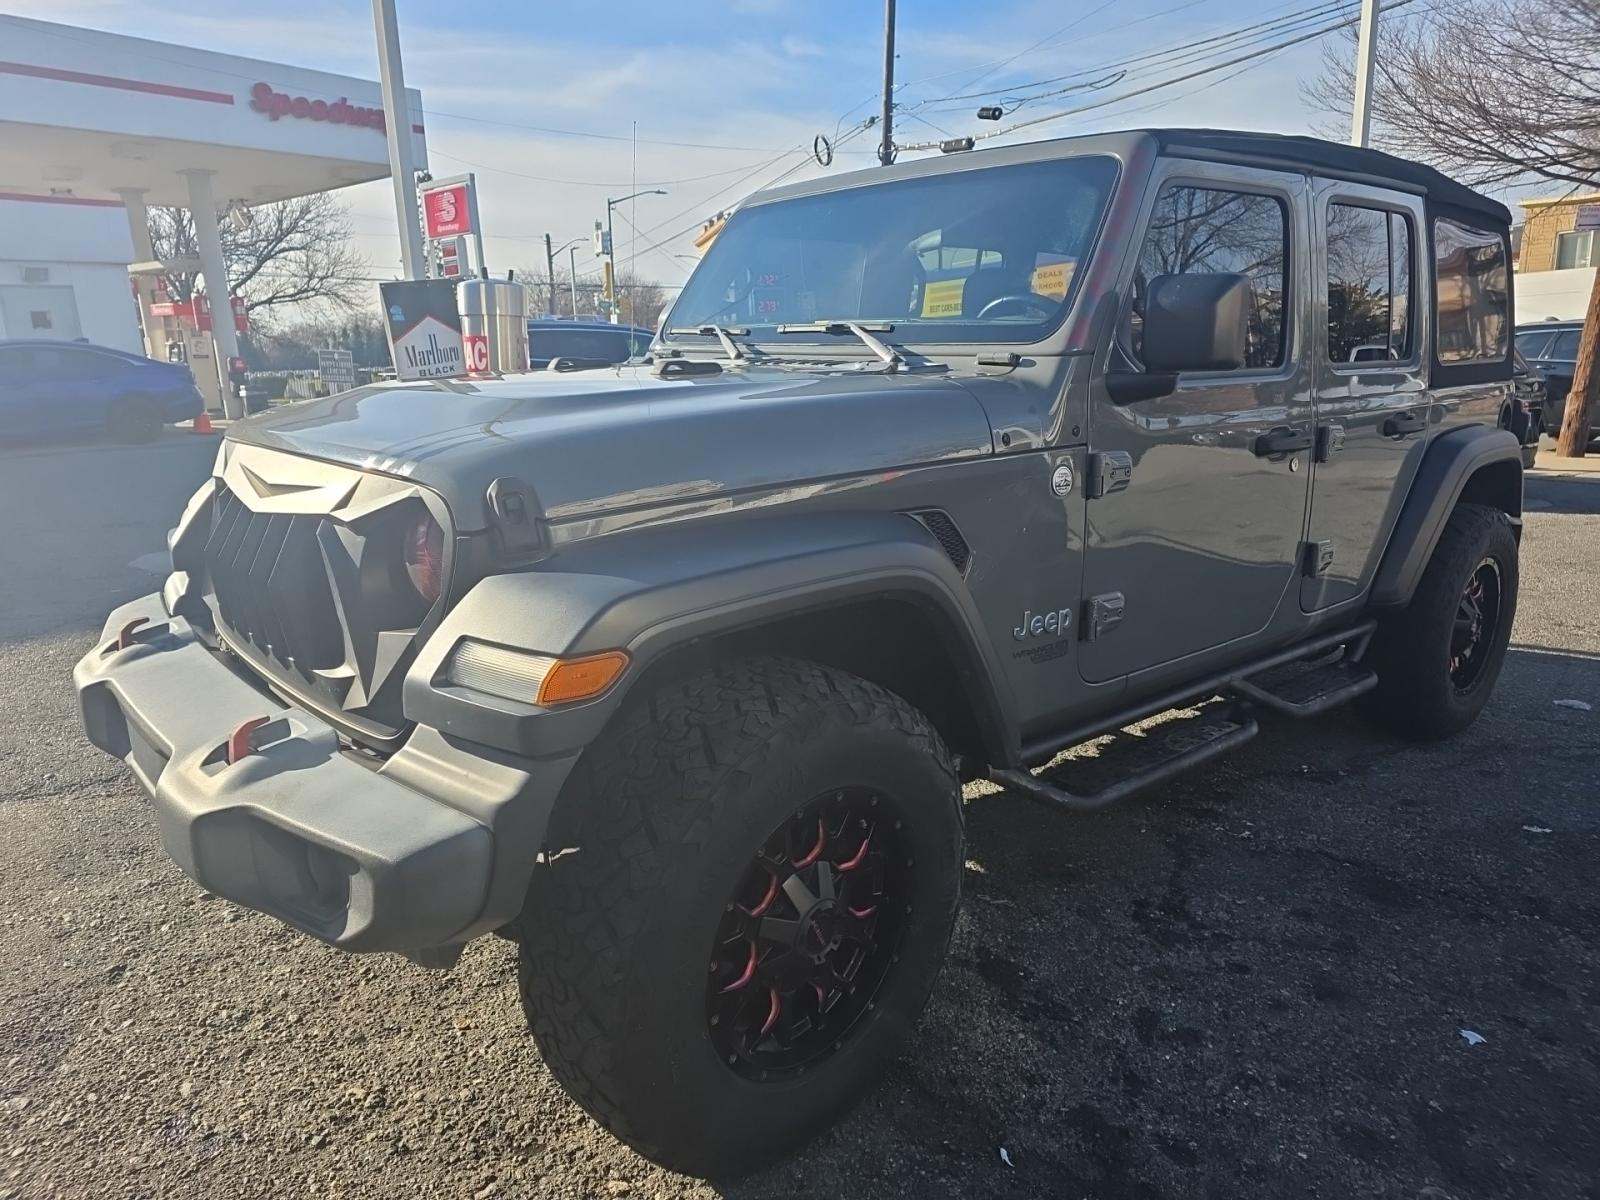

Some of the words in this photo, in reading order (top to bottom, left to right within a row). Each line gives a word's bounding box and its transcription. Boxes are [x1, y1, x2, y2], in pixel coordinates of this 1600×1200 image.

[405, 333, 460, 369] Marlboro
[419, 365, 456, 377] BLACK
[1013, 608, 1071, 641] Jeep
